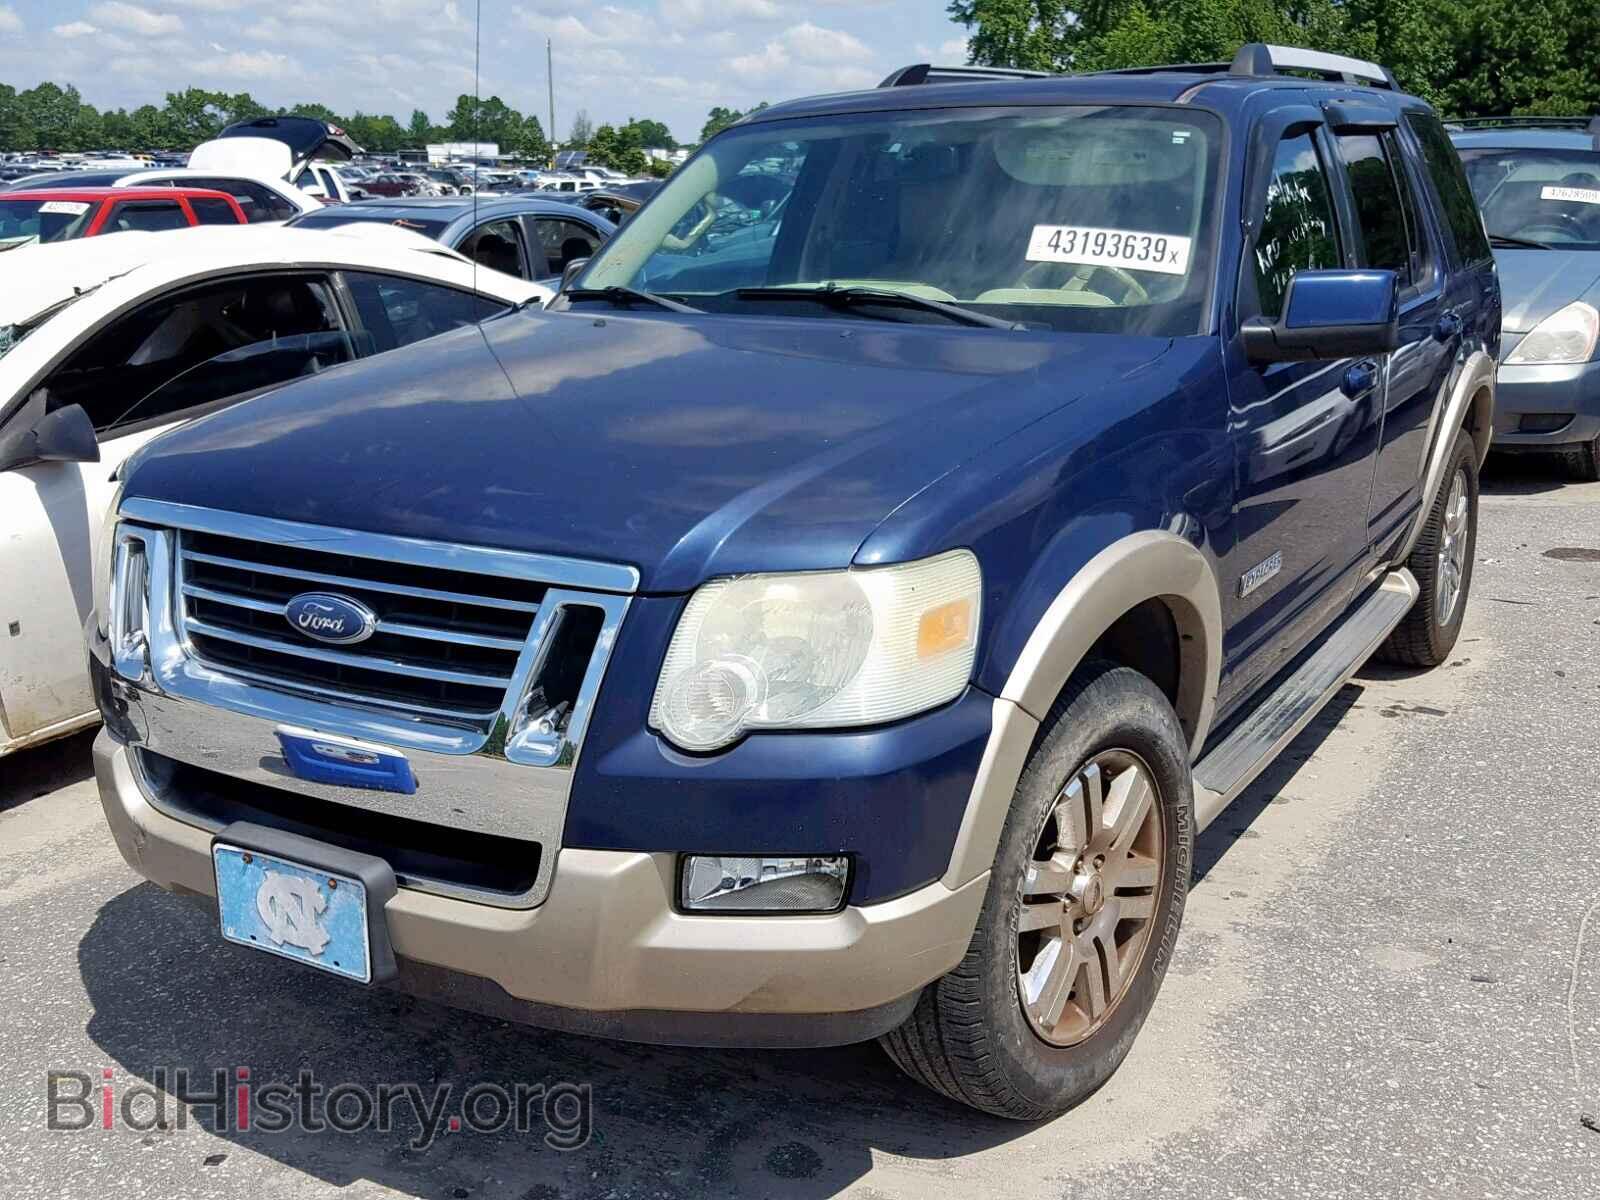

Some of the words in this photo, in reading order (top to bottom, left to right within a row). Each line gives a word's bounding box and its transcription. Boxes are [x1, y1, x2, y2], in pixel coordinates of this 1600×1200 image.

[1047, 229, 1168, 263] 43193639
[298, 601, 345, 633] Ford
[1152, 803, 1191, 978] MICHELIN
